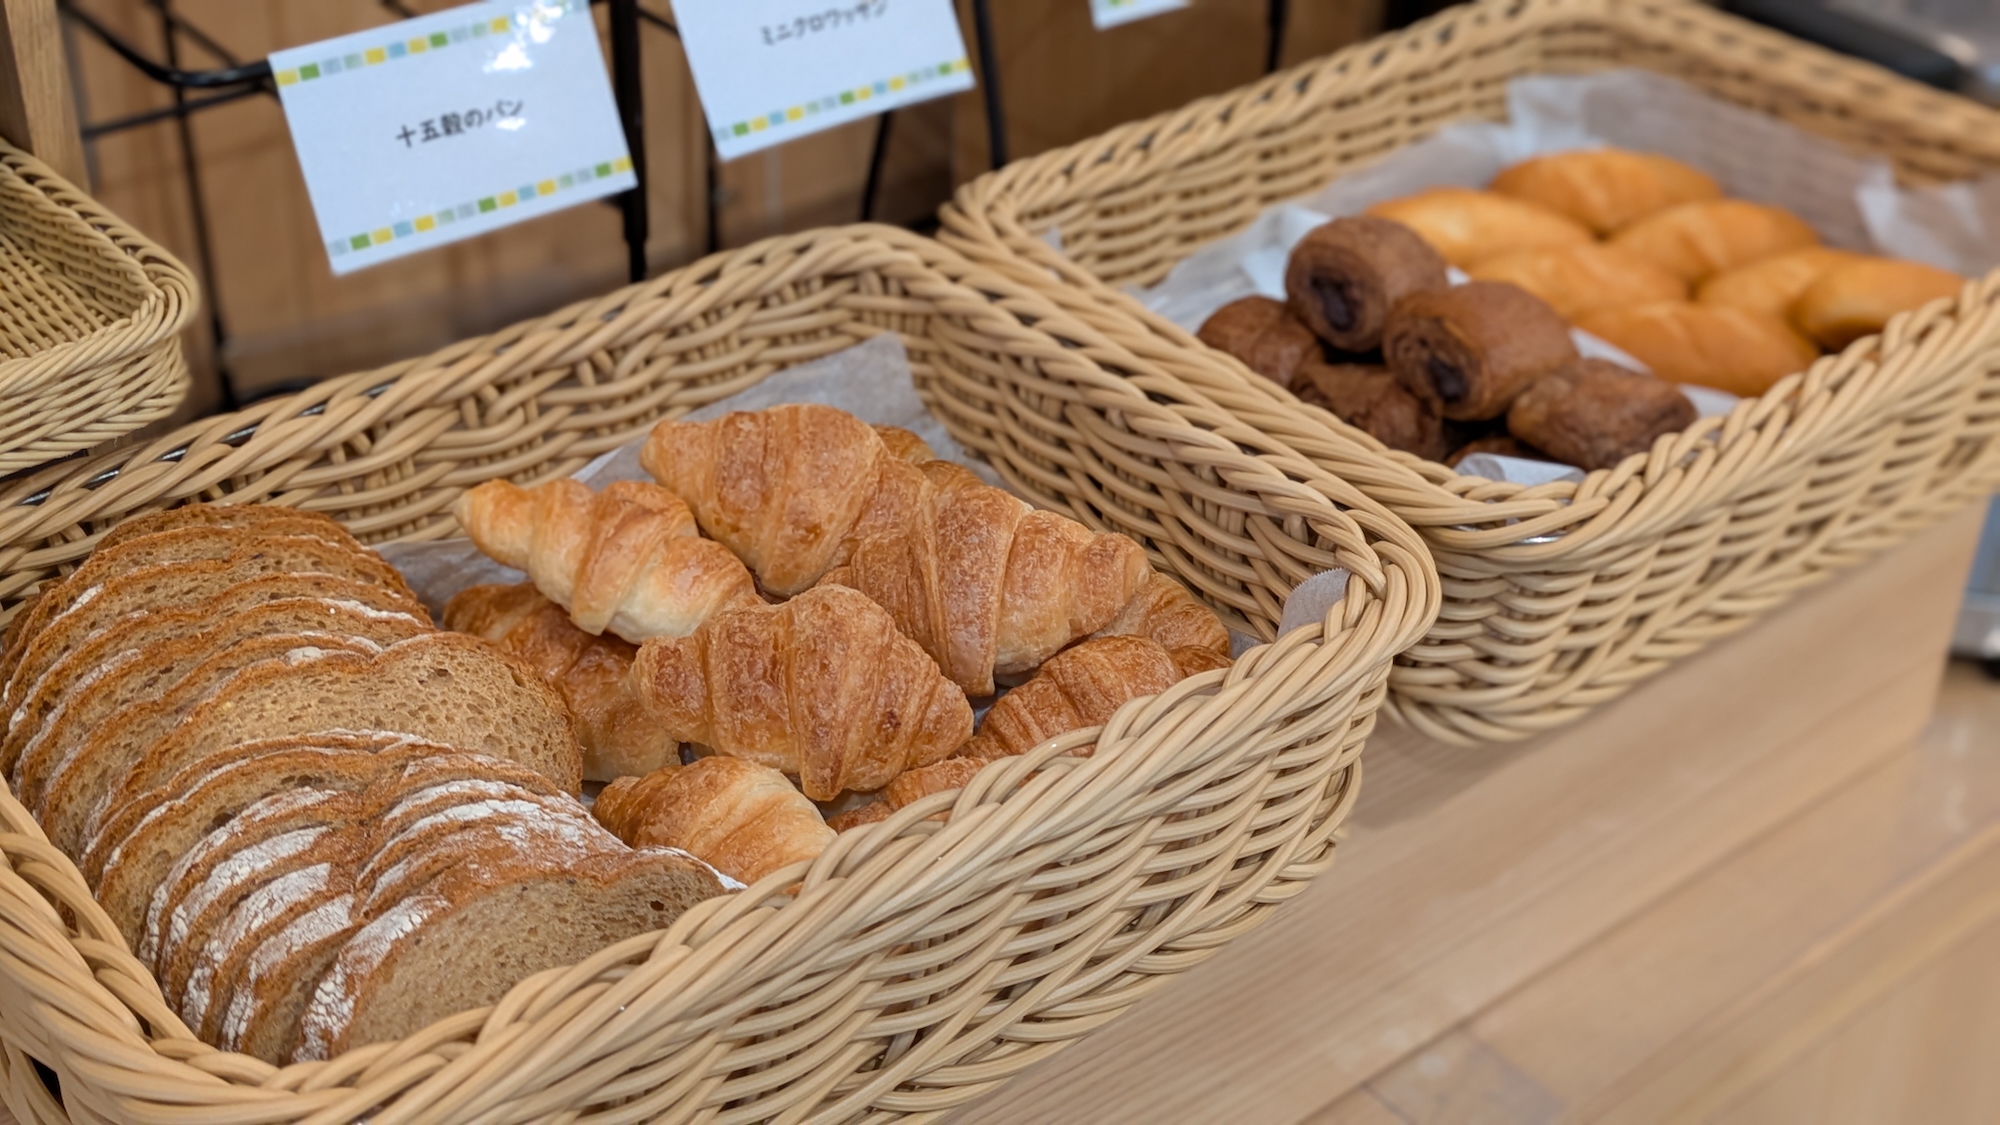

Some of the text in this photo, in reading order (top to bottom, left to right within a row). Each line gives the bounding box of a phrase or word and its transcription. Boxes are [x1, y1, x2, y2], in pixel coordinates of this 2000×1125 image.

[395, 99, 524, 148] 十五穀のパン
